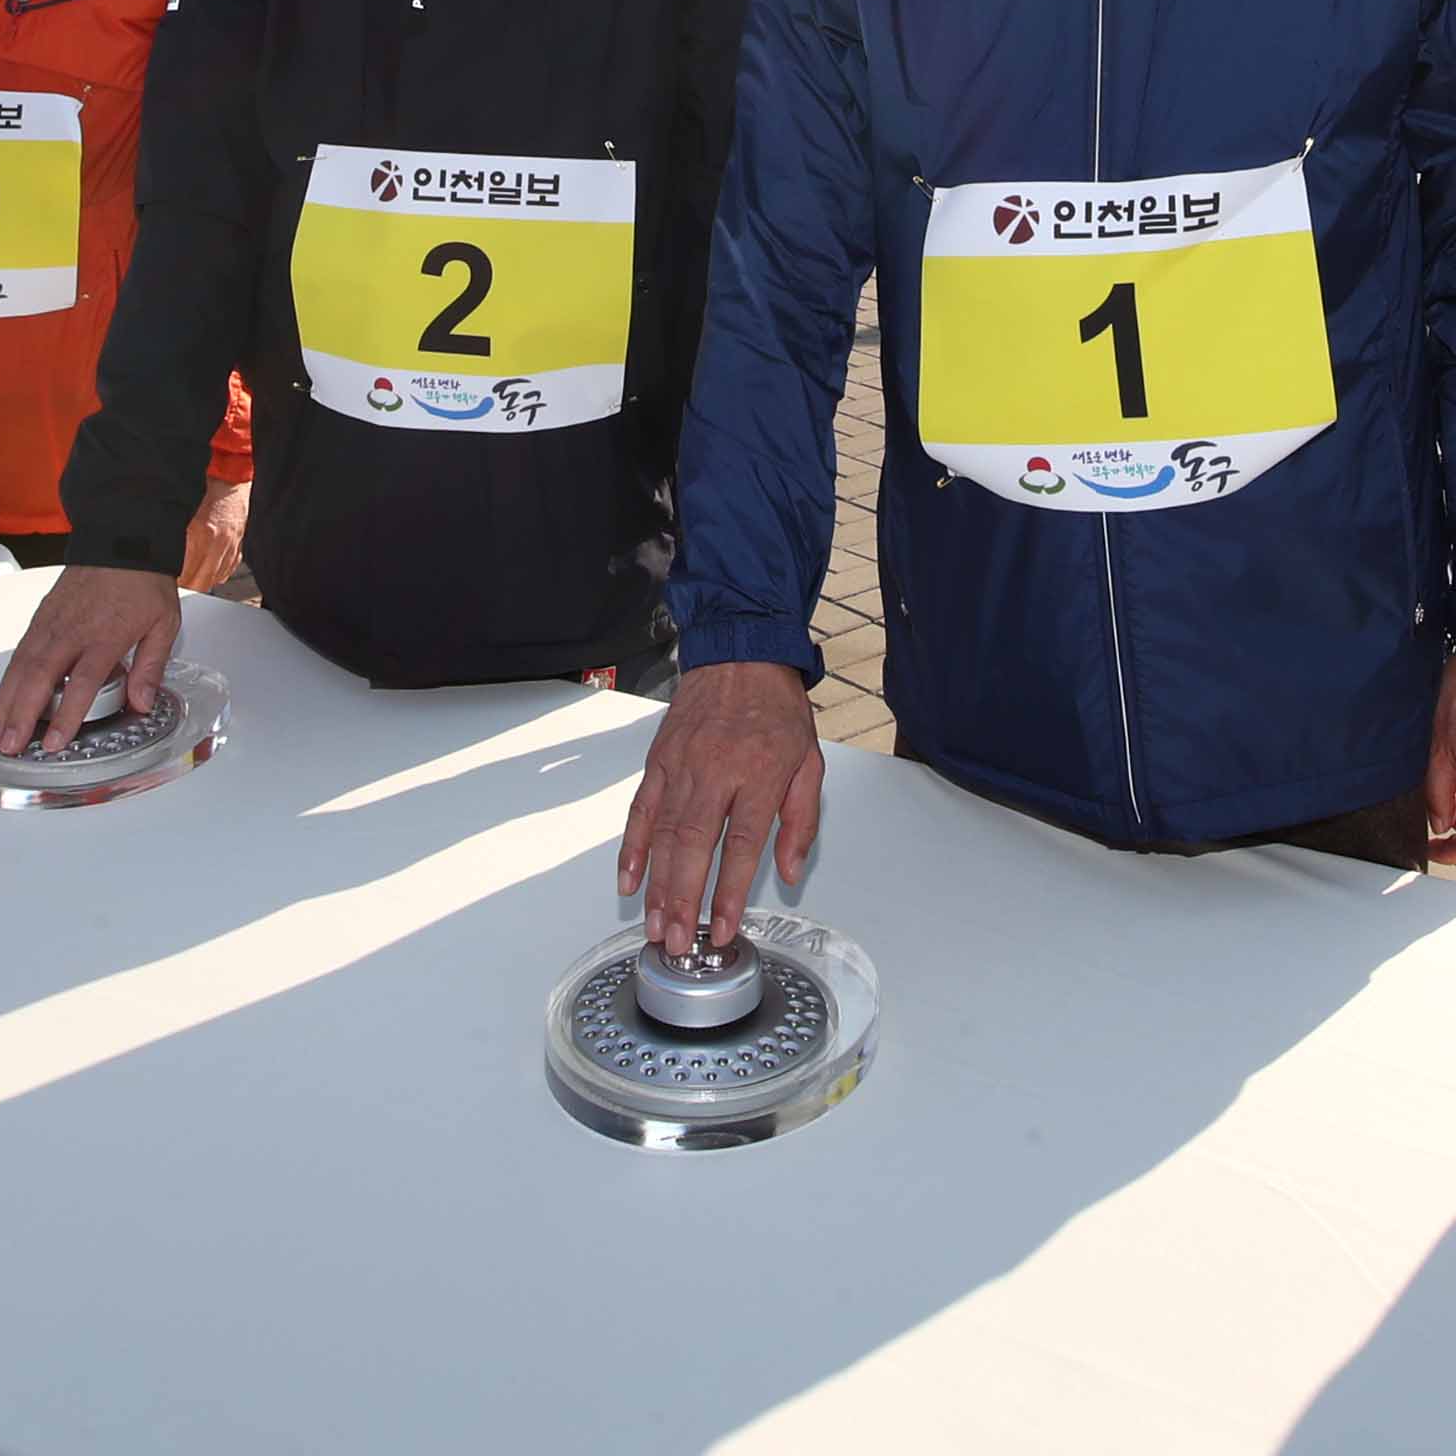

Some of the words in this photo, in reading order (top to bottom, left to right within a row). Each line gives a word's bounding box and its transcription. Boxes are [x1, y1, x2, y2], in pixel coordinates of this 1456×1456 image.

[412, 168, 561, 208] 인천일보
[1053, 192, 1221, 239] 인천일보
[418, 241, 493, 358] 2
[1079, 282, 1149, 419] 1
[492, 378, 547, 426] 동구
[1072, 449, 1104, 464] 새로운
[1105, 447, 1133, 463] 변화
[1171, 441, 1240, 494] 동구
